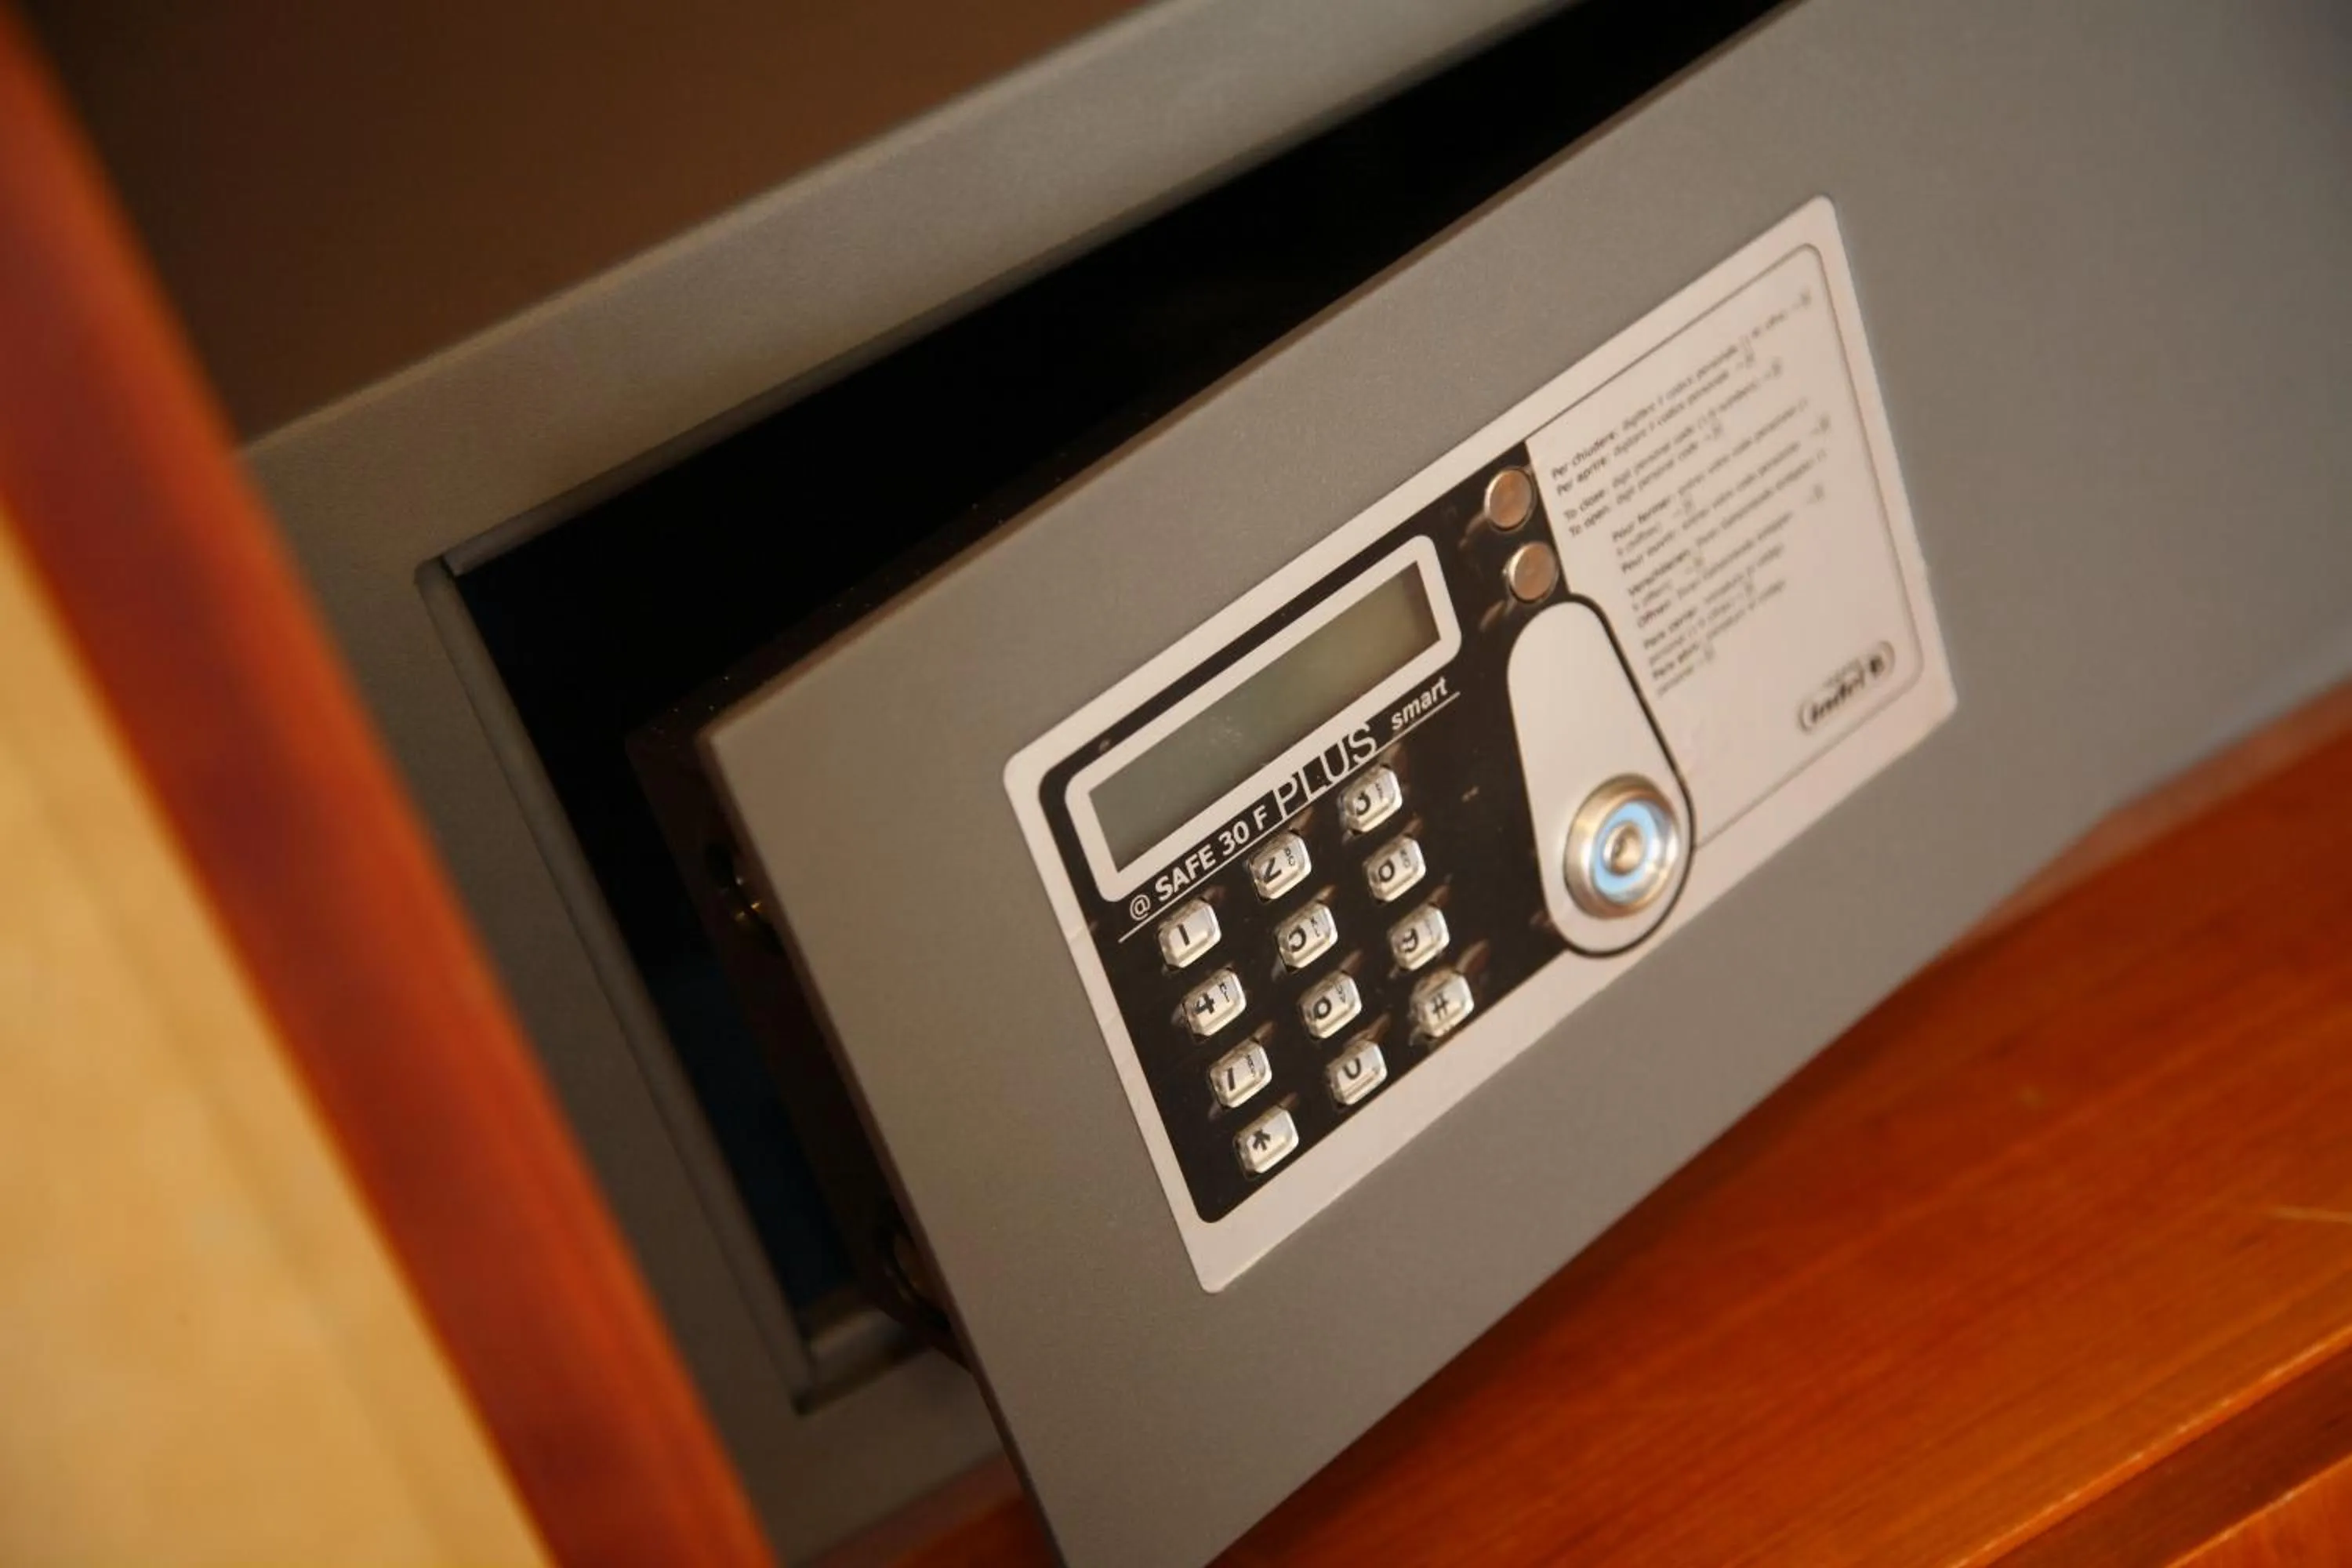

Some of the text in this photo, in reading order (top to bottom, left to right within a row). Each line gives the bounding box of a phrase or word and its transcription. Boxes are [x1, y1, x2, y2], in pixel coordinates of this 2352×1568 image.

[1552, 464, 1567, 478] Per
[1556, 481, 1572, 495] Per
[1156, 844, 1215, 901] SAFE
[1218, 821, 1249, 855] 30
[1253, 805, 1268, 830] F
[1275, 723, 1377, 818] PLUS
[1392, 677, 1447, 730] smart
